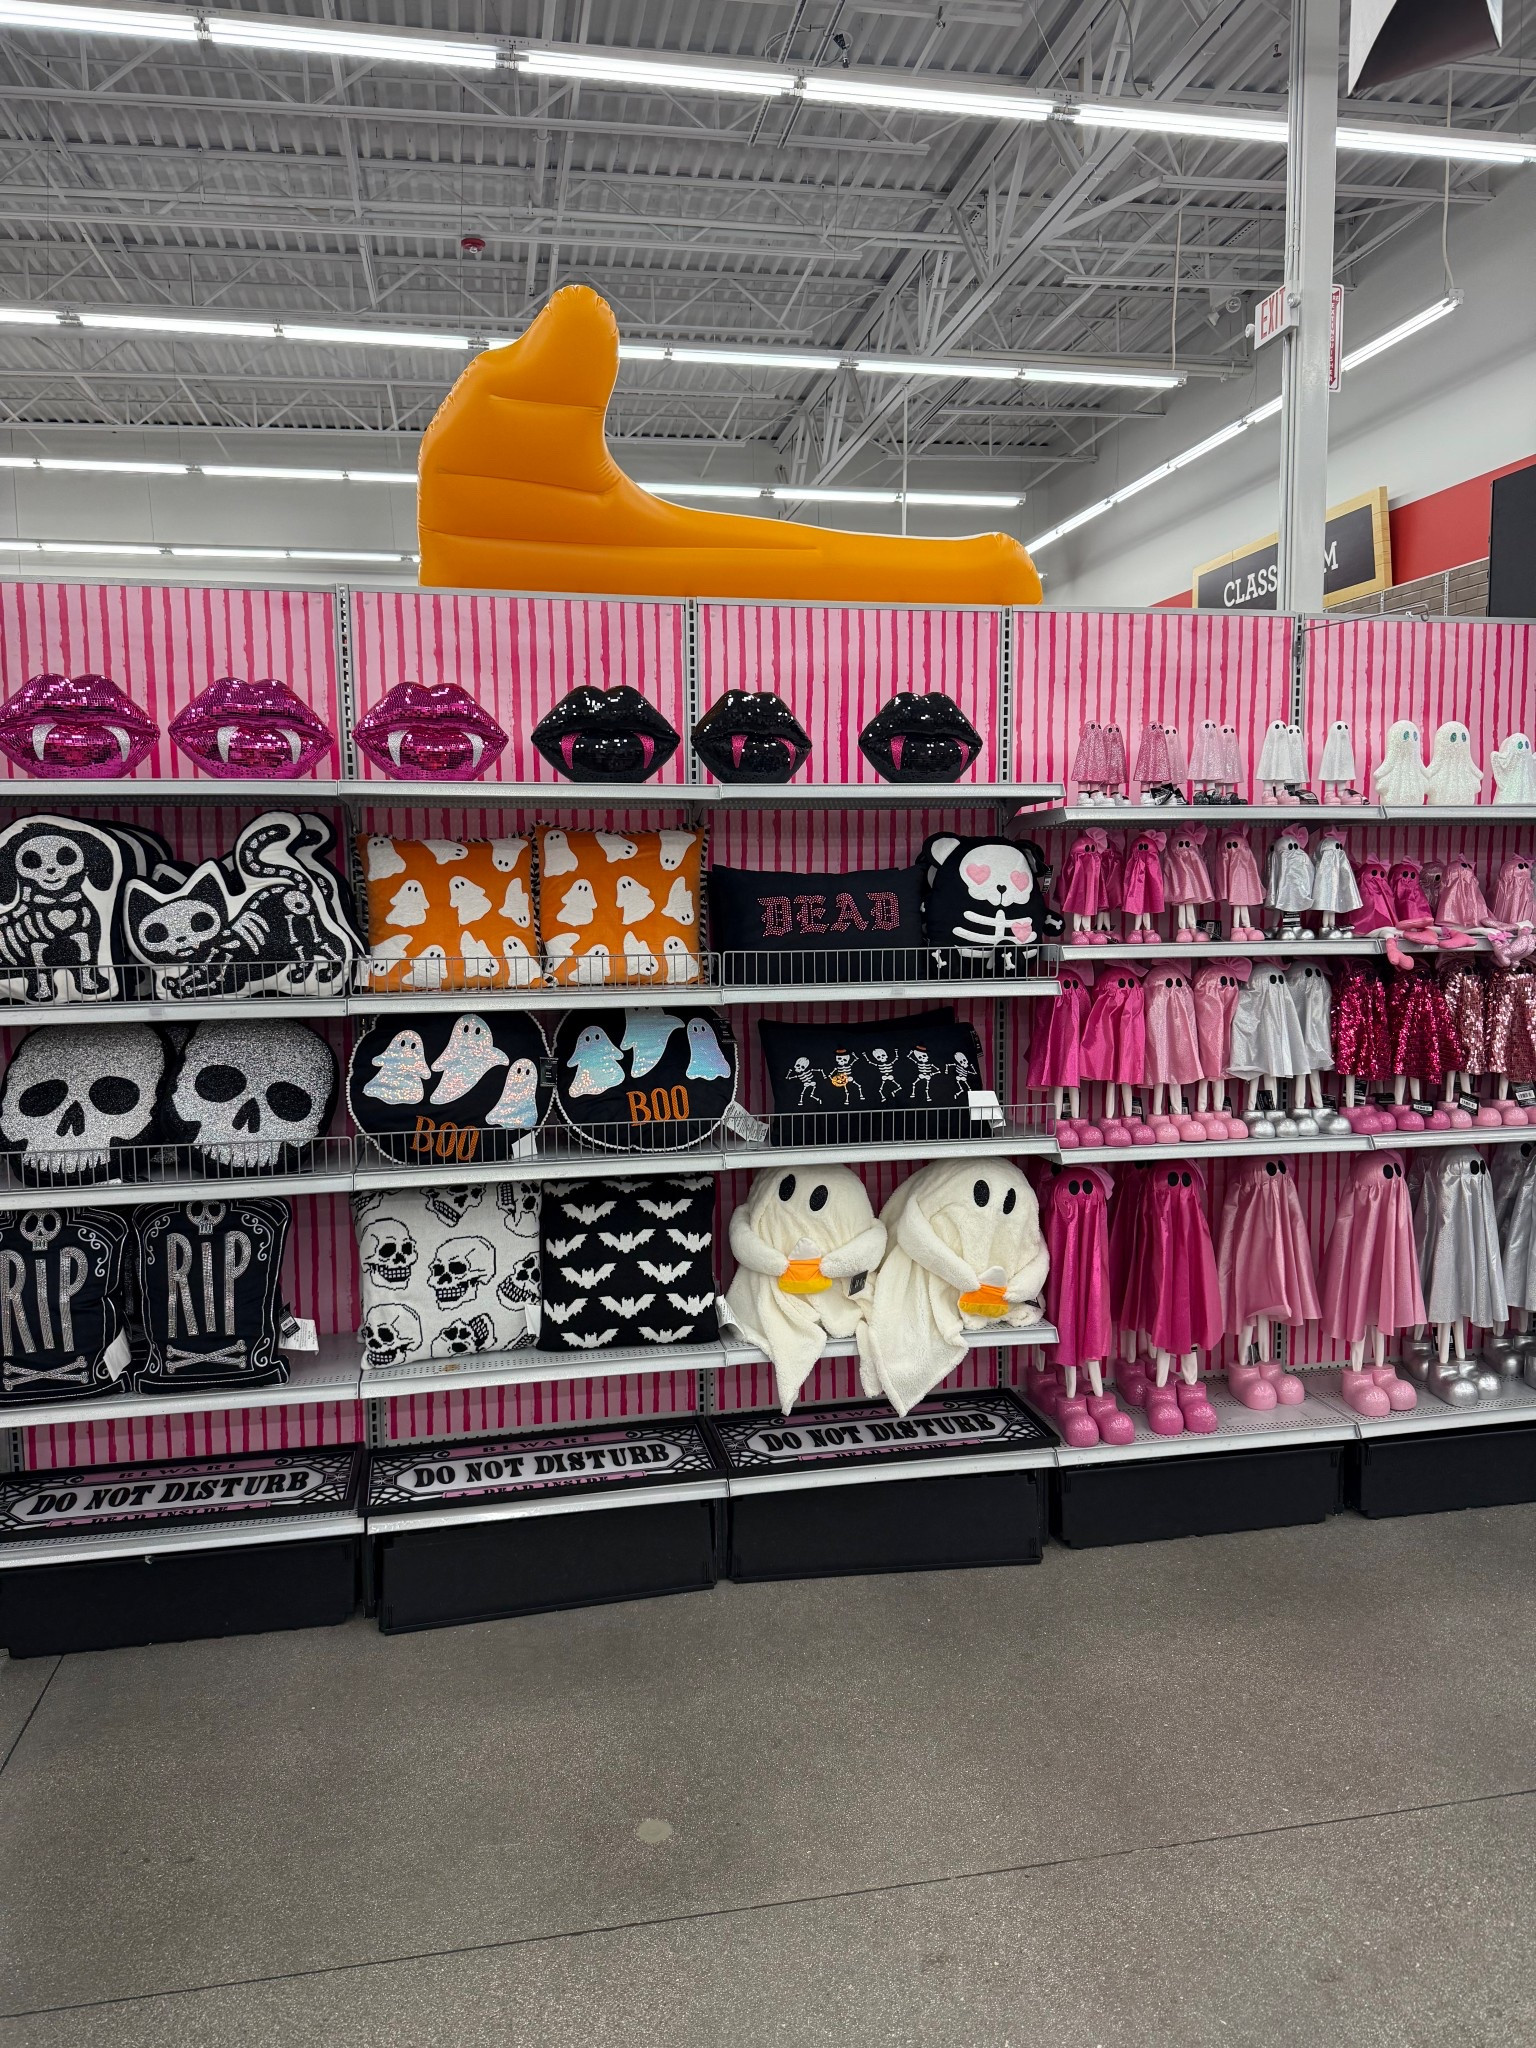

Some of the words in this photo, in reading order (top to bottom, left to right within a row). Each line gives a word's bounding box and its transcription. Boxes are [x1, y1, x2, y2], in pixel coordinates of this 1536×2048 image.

[1260, 286, 1286, 340] EXIT
[757, 891, 902, 937] DEAD
[626, 1085, 690, 1127] BOO
[410, 1115, 480, 1161] BOO
[758, 1431, 802, 1452] DO
[806, 1425, 864, 1447] NOT
[865, 1413, 996, 1442] DISTURB
[413, 1465, 456, 1488] DO
[465, 1457, 524, 1483] NOT
[534, 1443, 671, 1475] DISTURB
[26, 1491, 78, 1516] DO
[84, 1484, 154, 1511] NOT
[157, 1471, 310, 1504] DISTURB
